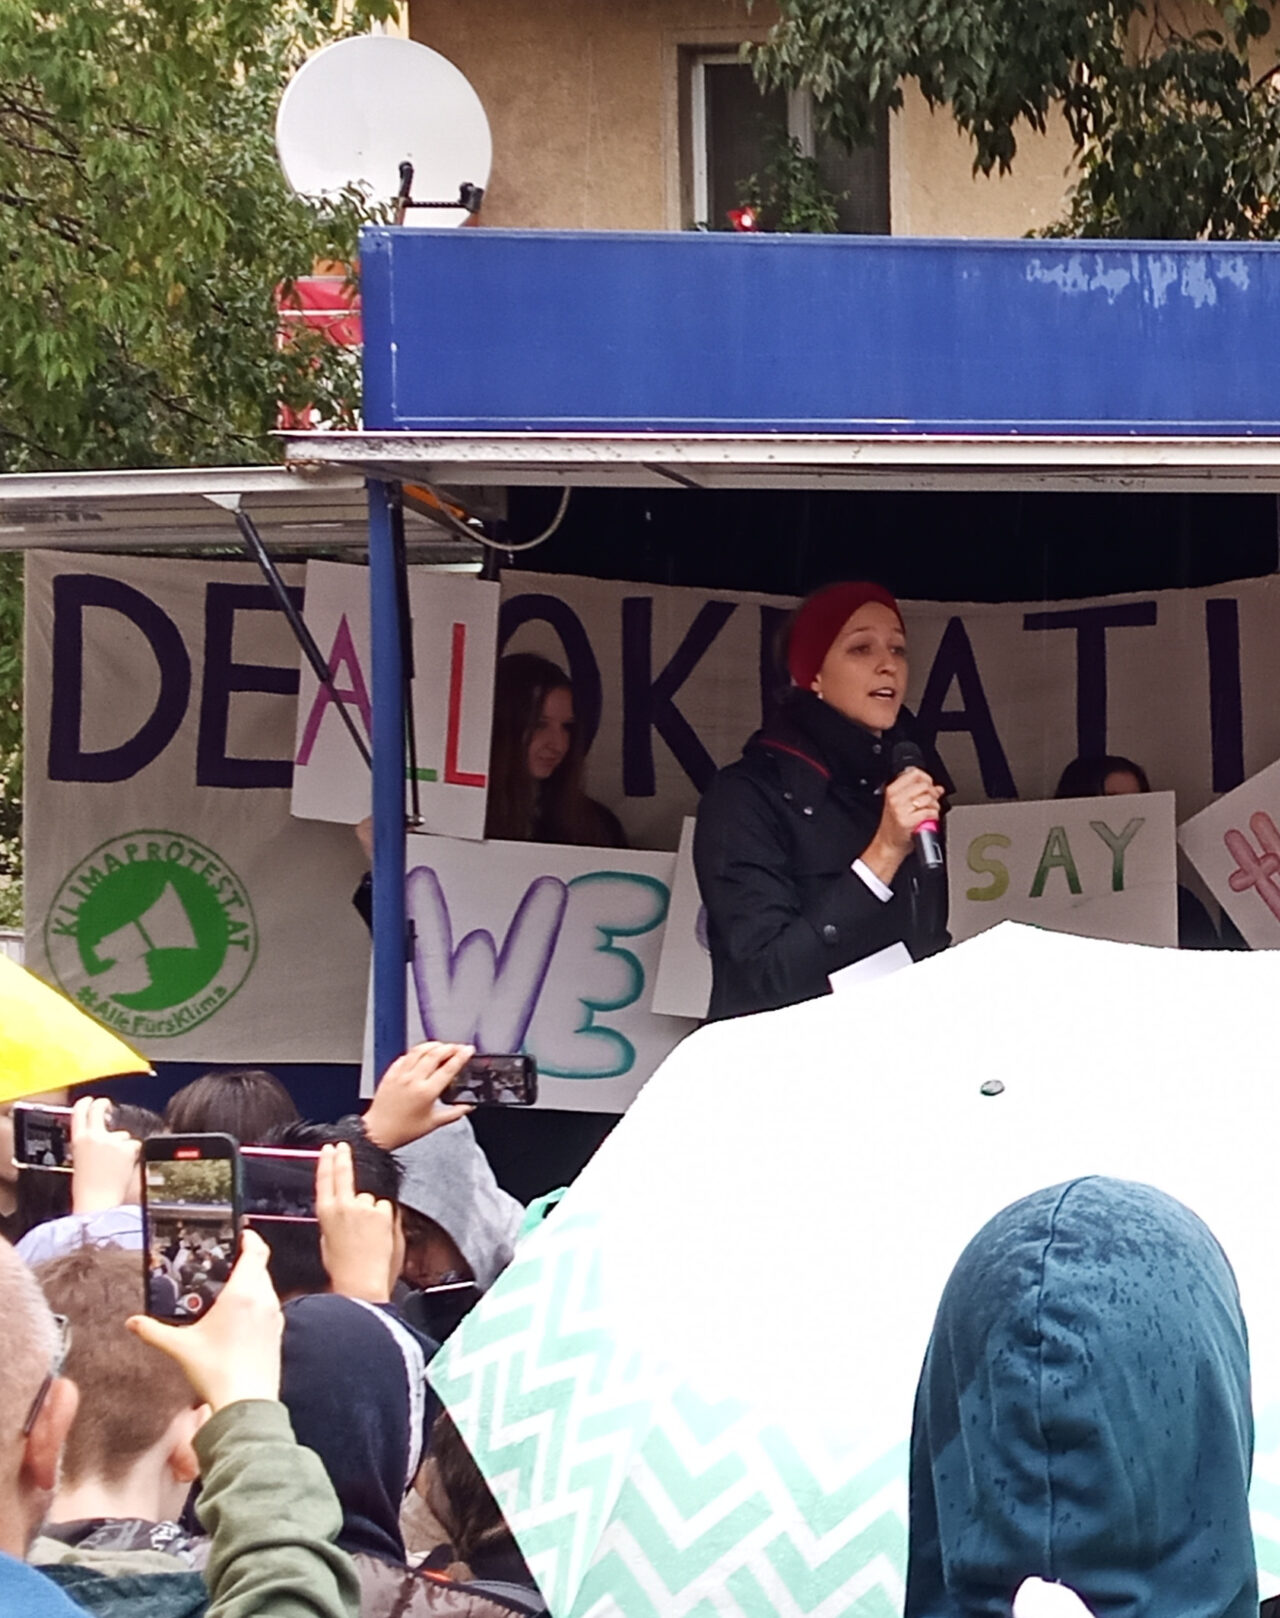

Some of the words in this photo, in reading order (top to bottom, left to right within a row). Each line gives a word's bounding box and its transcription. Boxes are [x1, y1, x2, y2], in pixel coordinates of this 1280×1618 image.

[295, 612, 486, 788] AL
[51, 841, 249, 952] KLIMAPROTEST.AT
[966, 818, 1146, 901] SAY
[405, 865, 671, 1079] WE
